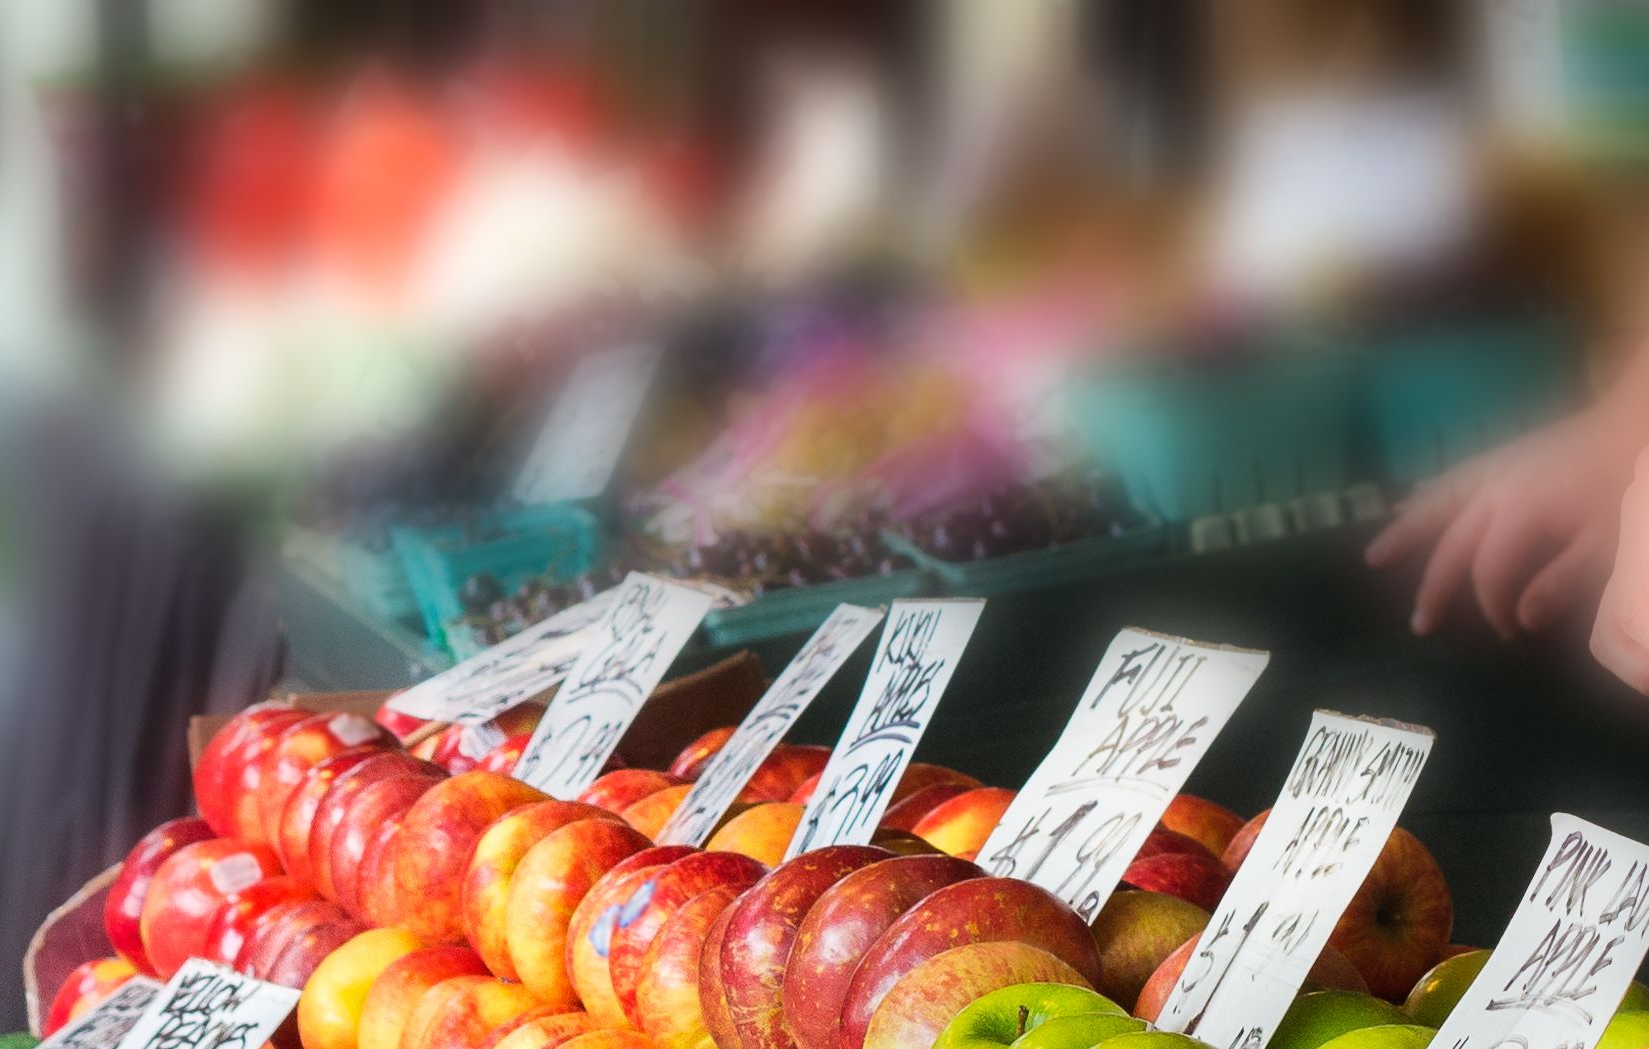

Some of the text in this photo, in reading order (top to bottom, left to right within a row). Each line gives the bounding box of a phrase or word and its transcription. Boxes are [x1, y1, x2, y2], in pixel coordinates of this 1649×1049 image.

[1089, 641, 1208, 719] FUJI
[1070, 714, 1209, 783] APPLE
[1529, 830, 1613, 917] PINK
[1503, 917, 1626, 1006] APPLE
